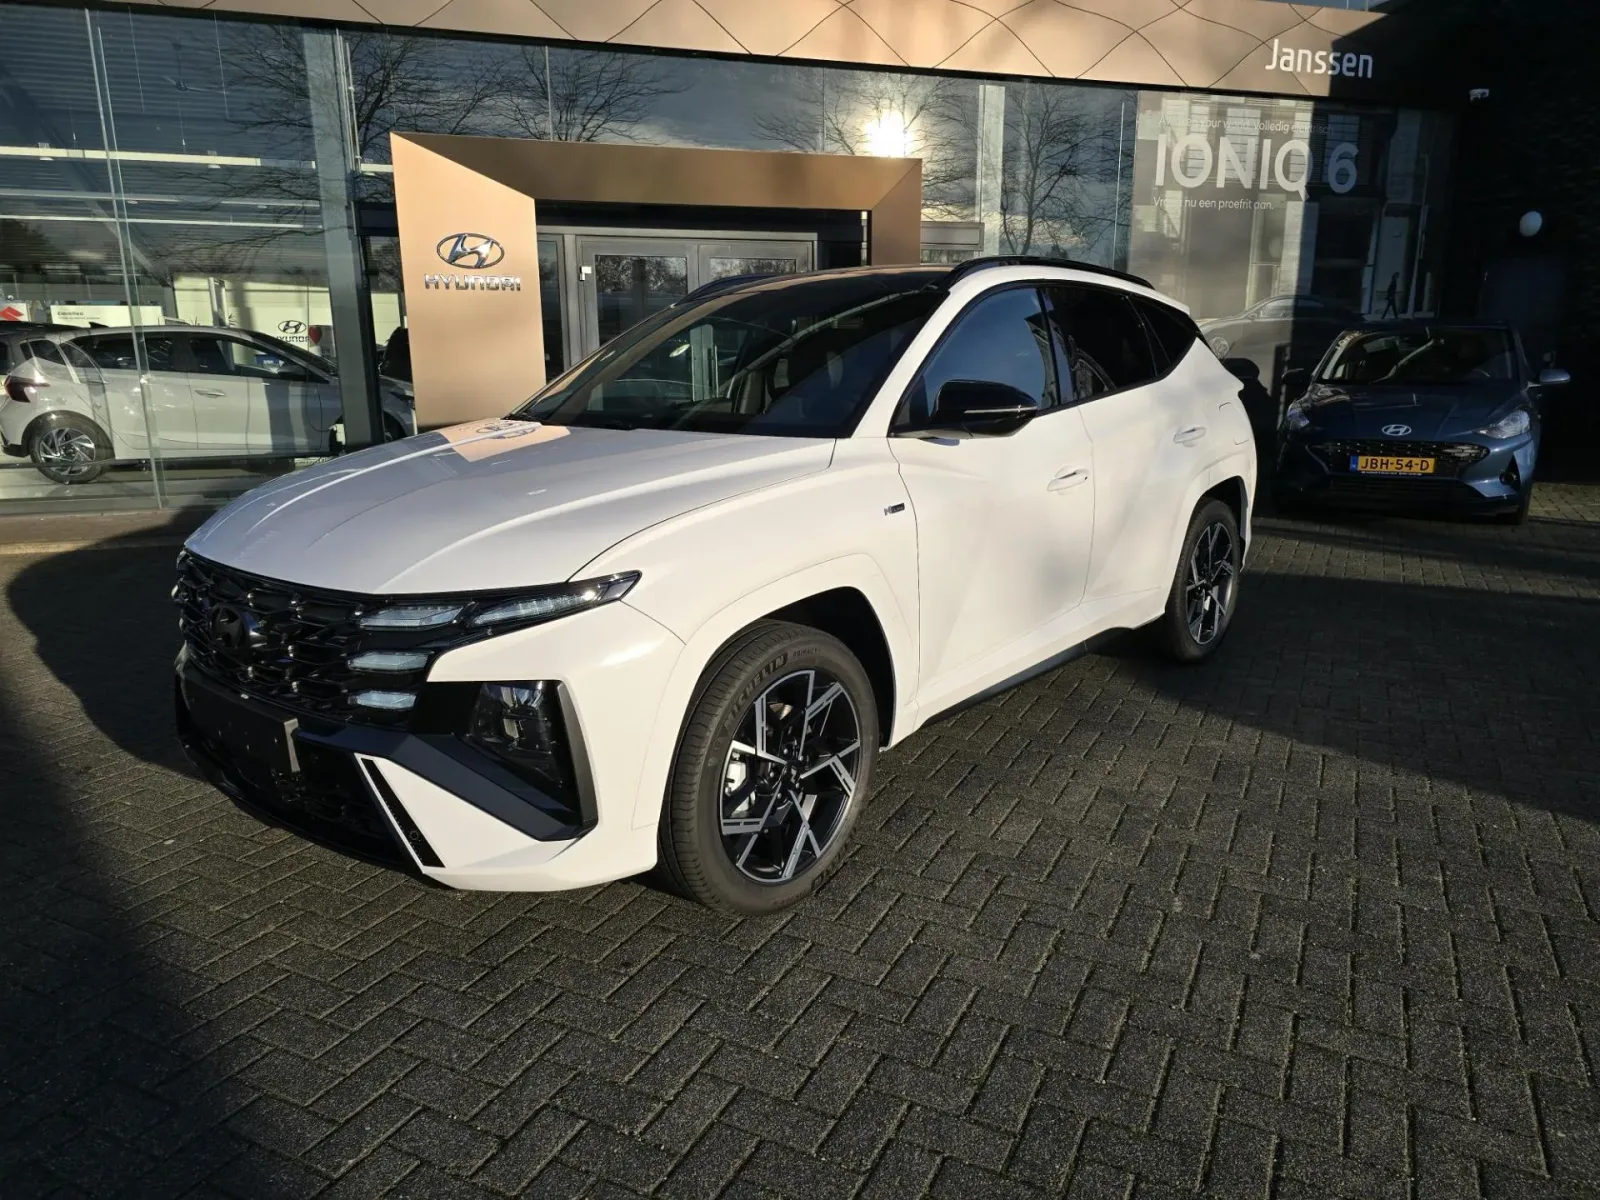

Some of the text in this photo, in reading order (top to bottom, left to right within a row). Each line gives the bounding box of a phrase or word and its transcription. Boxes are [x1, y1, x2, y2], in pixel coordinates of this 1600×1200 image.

[1264, 38, 1373, 78] Janssen
[1155, 133, 1359, 200] IONIQ 6
[1185, 199, 1197, 208] nu
[1199, 199, 1216, 209] een
[1218, 198, 1251, 211] proefrit
[424, 273, 521, 291] HYUNDAI
[1361, 458, 1430, 471] JBH-54-D
[723, 651, 788, 730] MICHELIN
